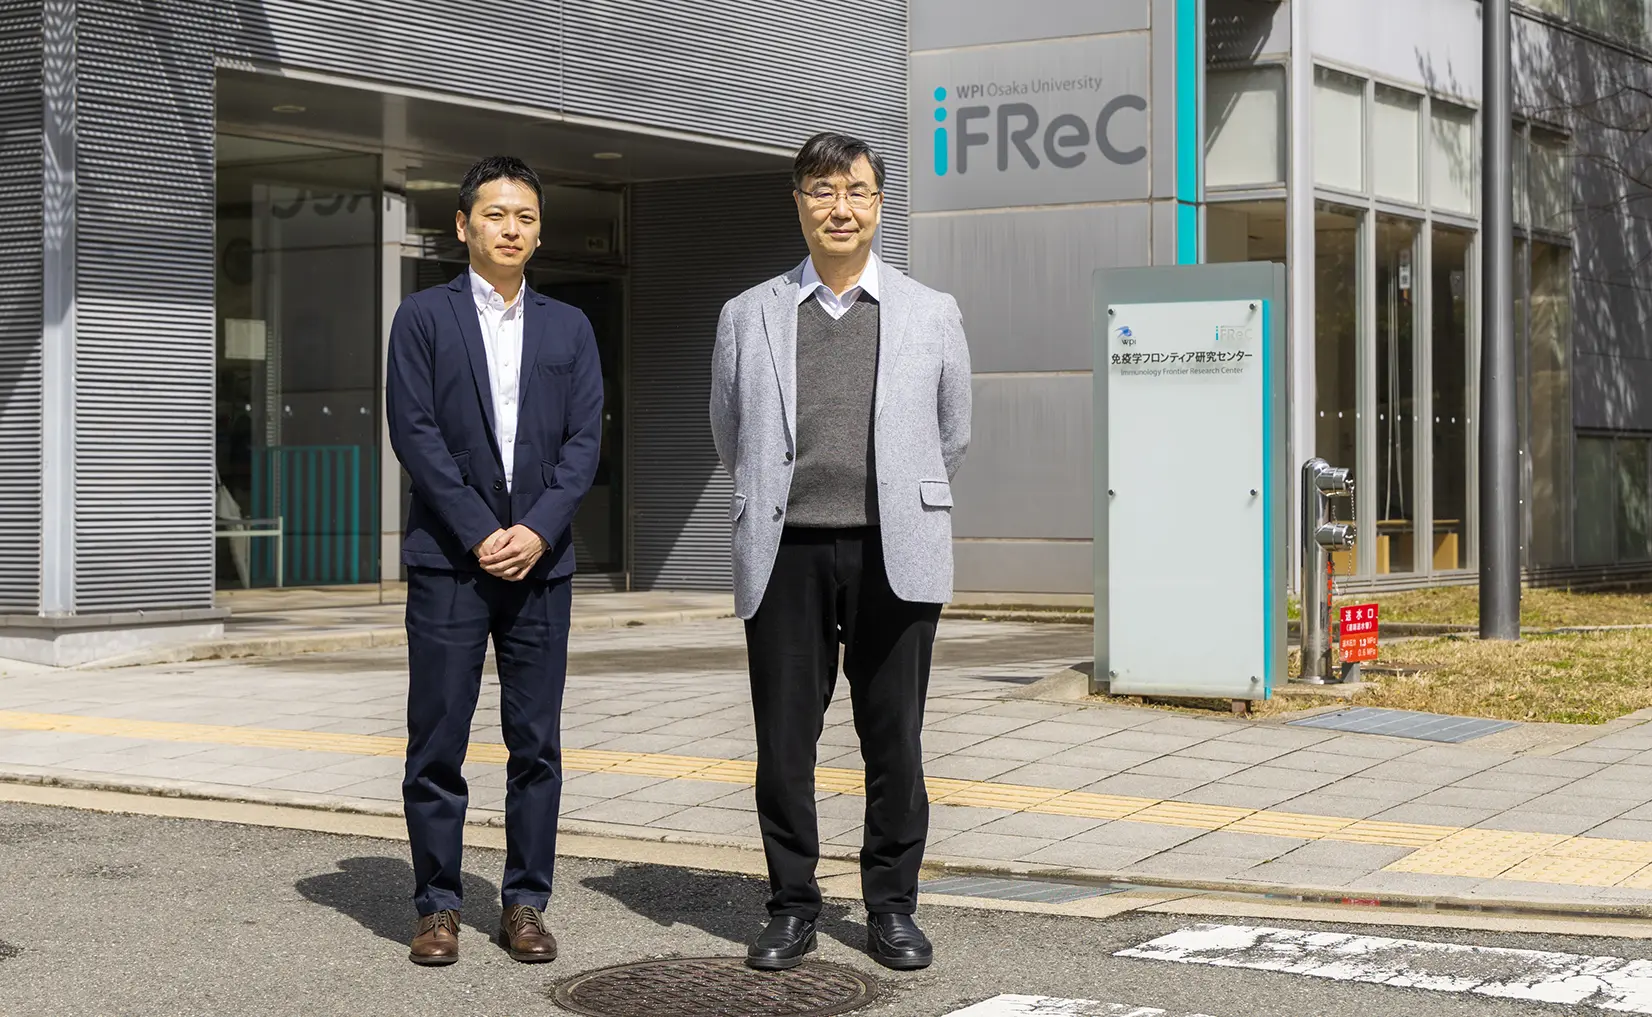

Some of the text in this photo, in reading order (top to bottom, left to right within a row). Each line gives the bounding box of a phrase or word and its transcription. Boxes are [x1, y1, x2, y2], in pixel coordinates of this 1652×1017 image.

[956, 75, 1103, 99] WPI Osaka University
[934, 86, 1147, 177] iFReC
[1111, 350, 1253, 365] 免疫学フロンティア研究センター
[1120, 366, 1243, 377] Immunology Frontier Research Center
